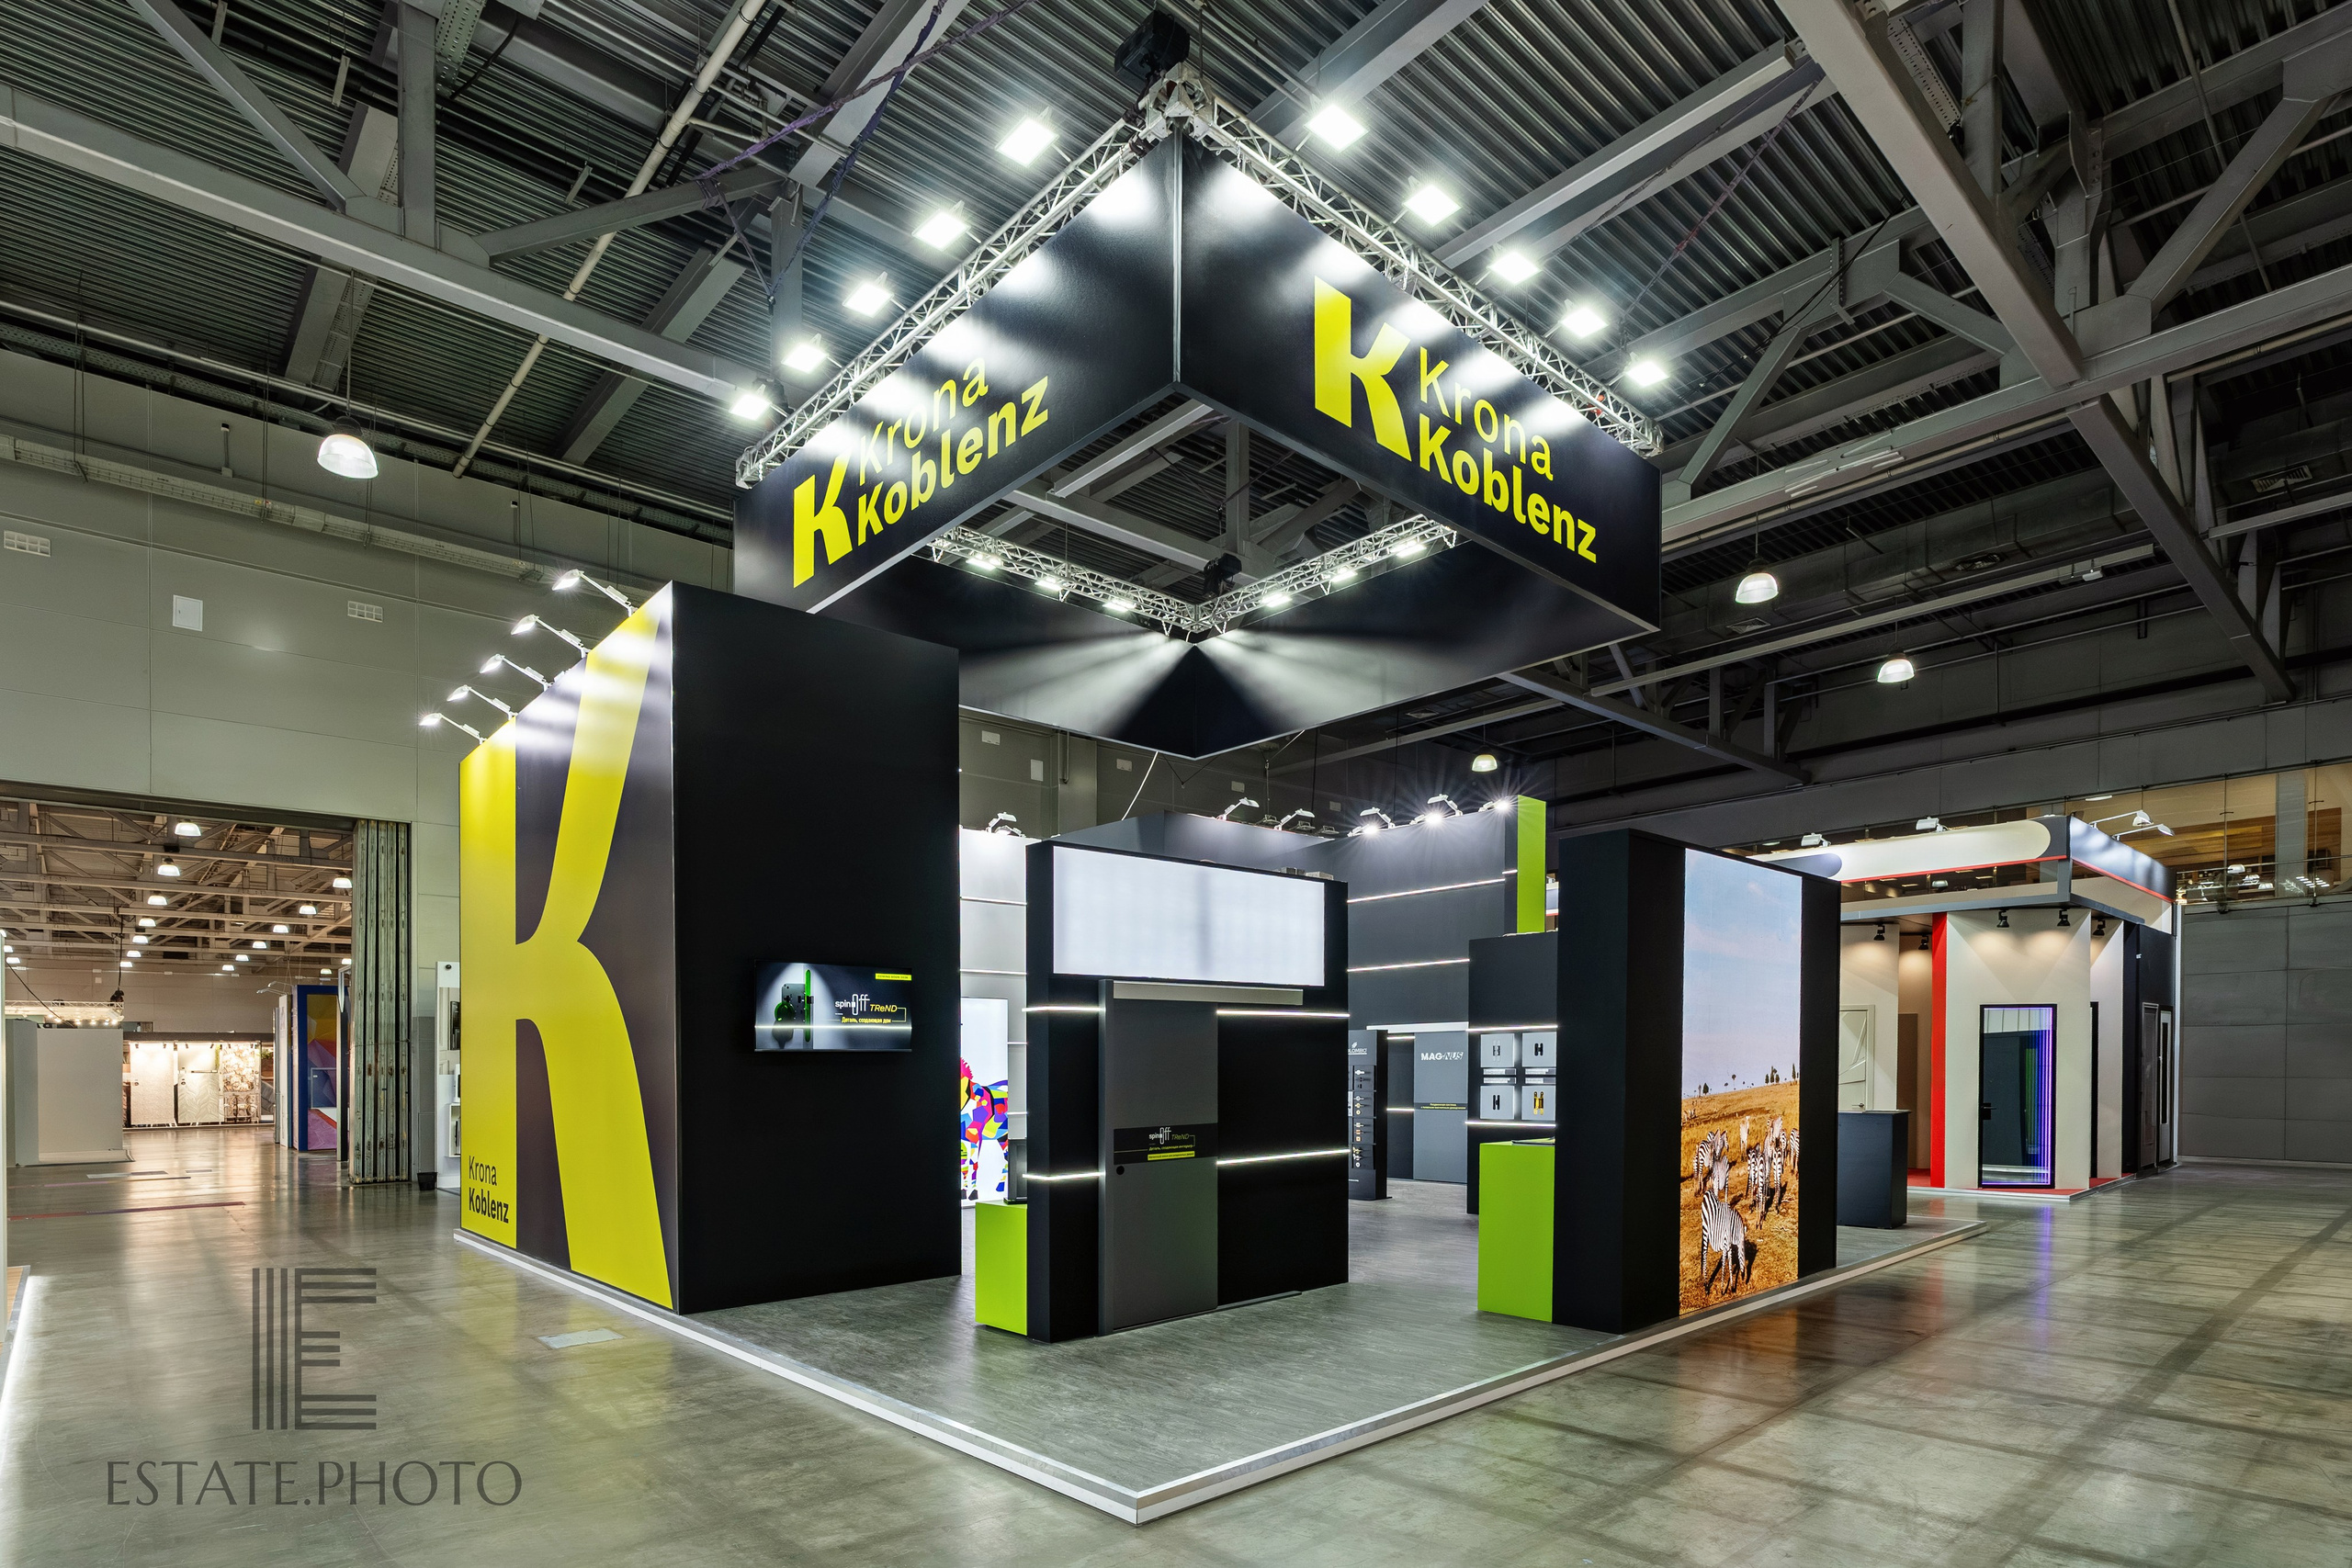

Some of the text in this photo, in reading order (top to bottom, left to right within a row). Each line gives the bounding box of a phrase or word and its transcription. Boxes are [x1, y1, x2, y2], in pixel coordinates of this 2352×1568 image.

[859, 356, 989, 487] Krona
[1314, 275, 1412, 461] K
[1419, 344, 1554, 481] Krona
[793, 446, 854, 589] K
[857, 375, 1049, 547] Koblenz
[1419, 412, 1598, 564] Koblenz
[469, 1155, 497, 1186] Krona
[469, 1186, 509, 1224] Koblenz
